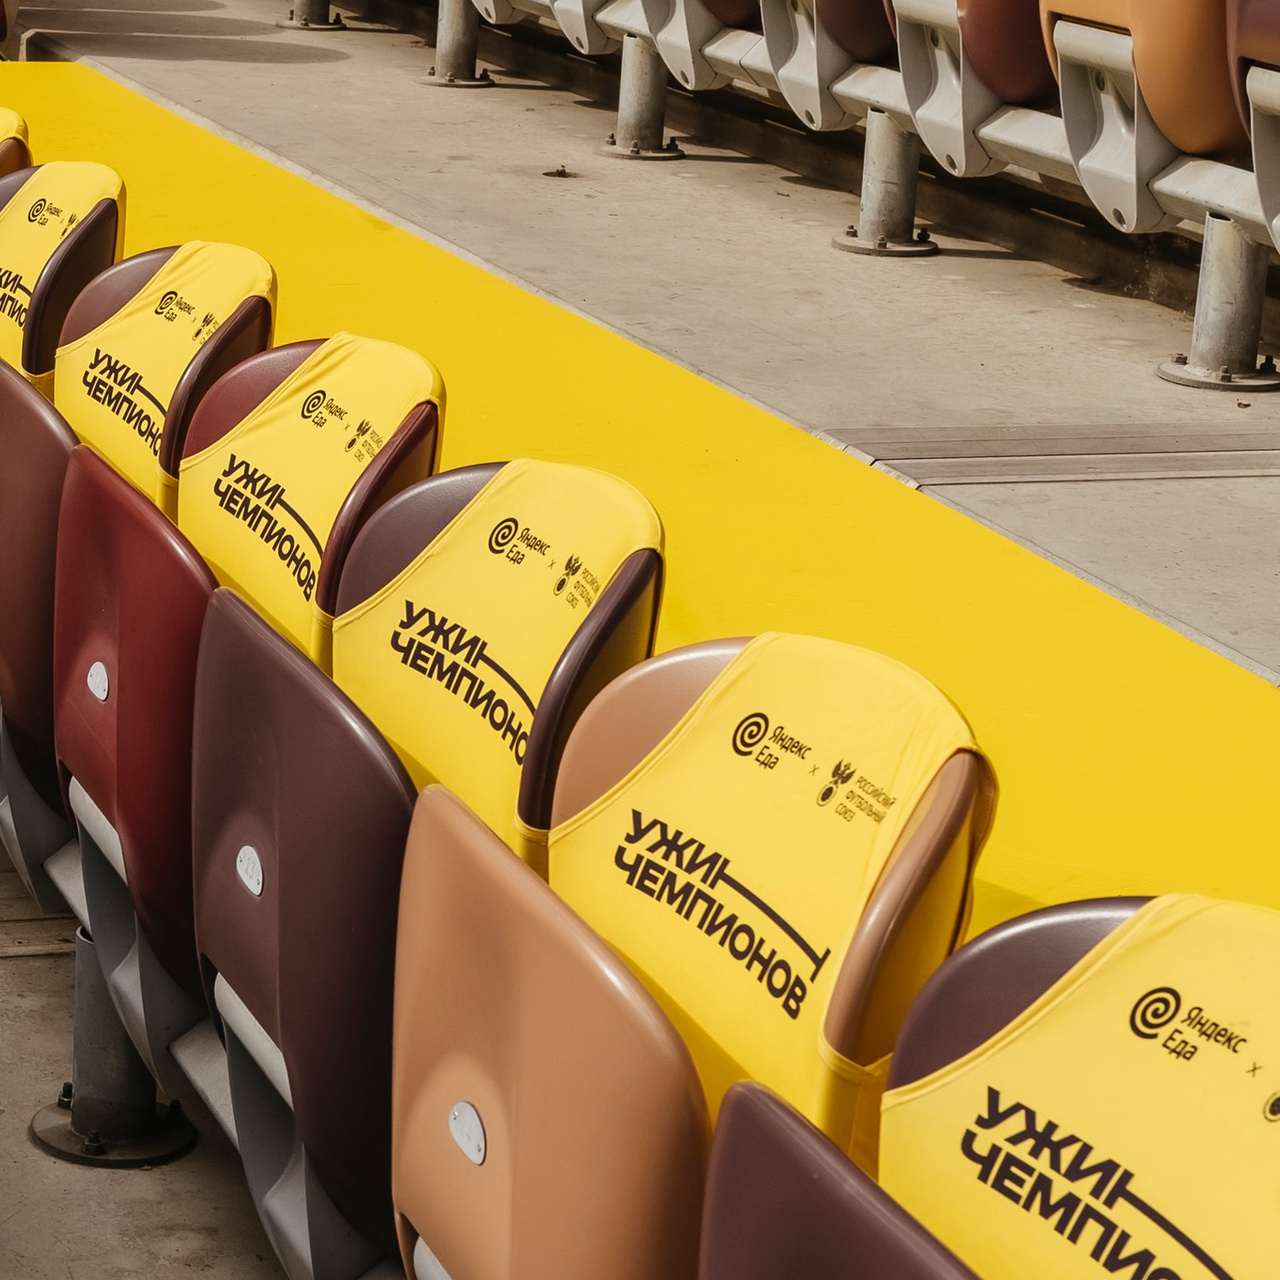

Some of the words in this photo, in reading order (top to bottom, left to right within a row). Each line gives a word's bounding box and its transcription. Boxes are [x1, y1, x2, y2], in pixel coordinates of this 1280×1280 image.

[82, 369, 163, 457] ЧЕМПИОНО
[311, 410, 328, 428] Еда
[322, 397, 349, 421] Яндекс
[213, 477, 316, 603] ЧЕМПИОНОВ
[505, 543, 526, 565] Еда
[516, 526, 551, 556] Яндекс
[390, 629, 530, 767] ЧЕМПИОНО
[754, 744, 780, 770] Еда
[768, 725, 813, 761] Яндекс
[624, 808, 832, 984] УЖИН
[614, 844, 808, 1021] ЧЕМПИОНОВ
[1161, 1028, 1199, 1062] Еда
[1180, 1005, 1248, 1055] Яндекс
